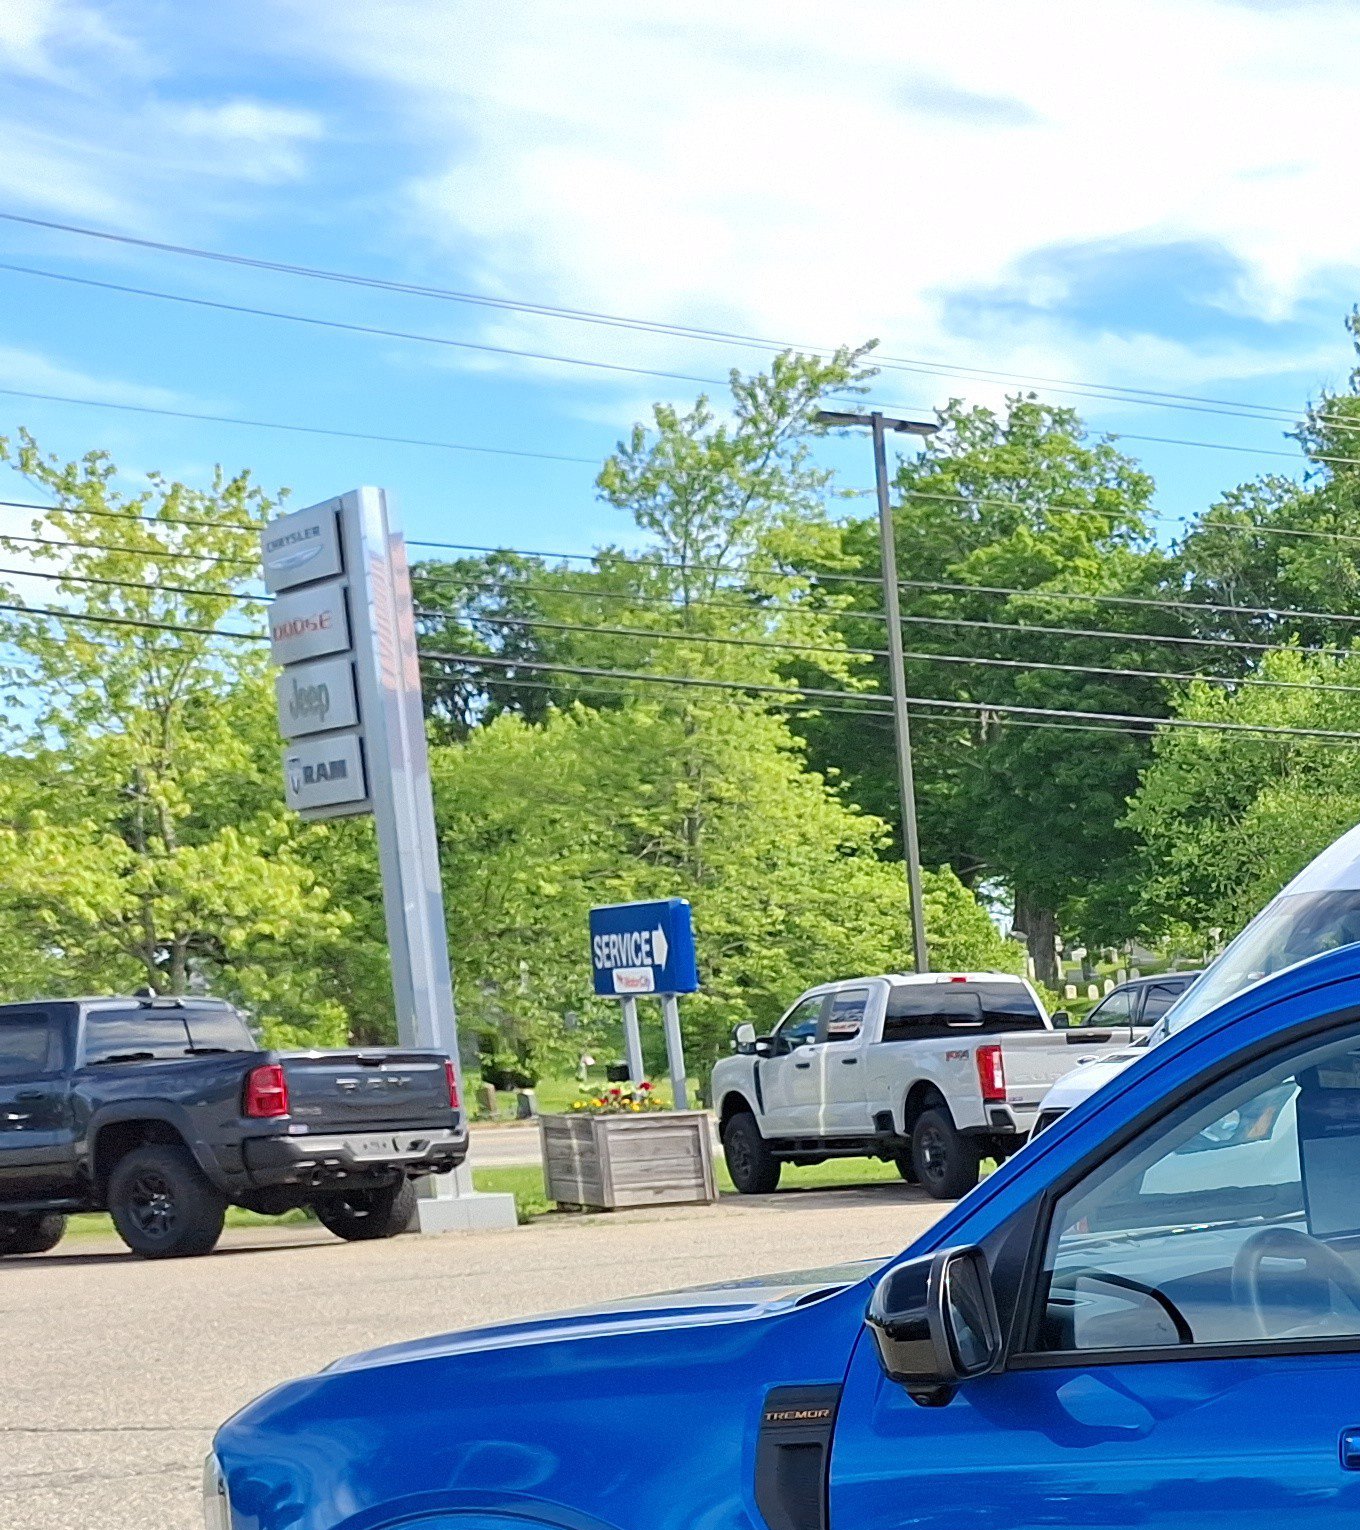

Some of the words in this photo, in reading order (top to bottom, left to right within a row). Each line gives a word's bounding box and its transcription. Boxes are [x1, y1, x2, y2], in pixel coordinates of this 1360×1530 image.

[267, 525, 321, 553] CHRYSLER
[273, 609, 333, 642] DODGE
[289, 677, 330, 723] Jeep
[302, 758, 348, 785] RAM
[593, 930, 653, 970] SERVICE
[764, 1409, 830, 1421] TREMOR
